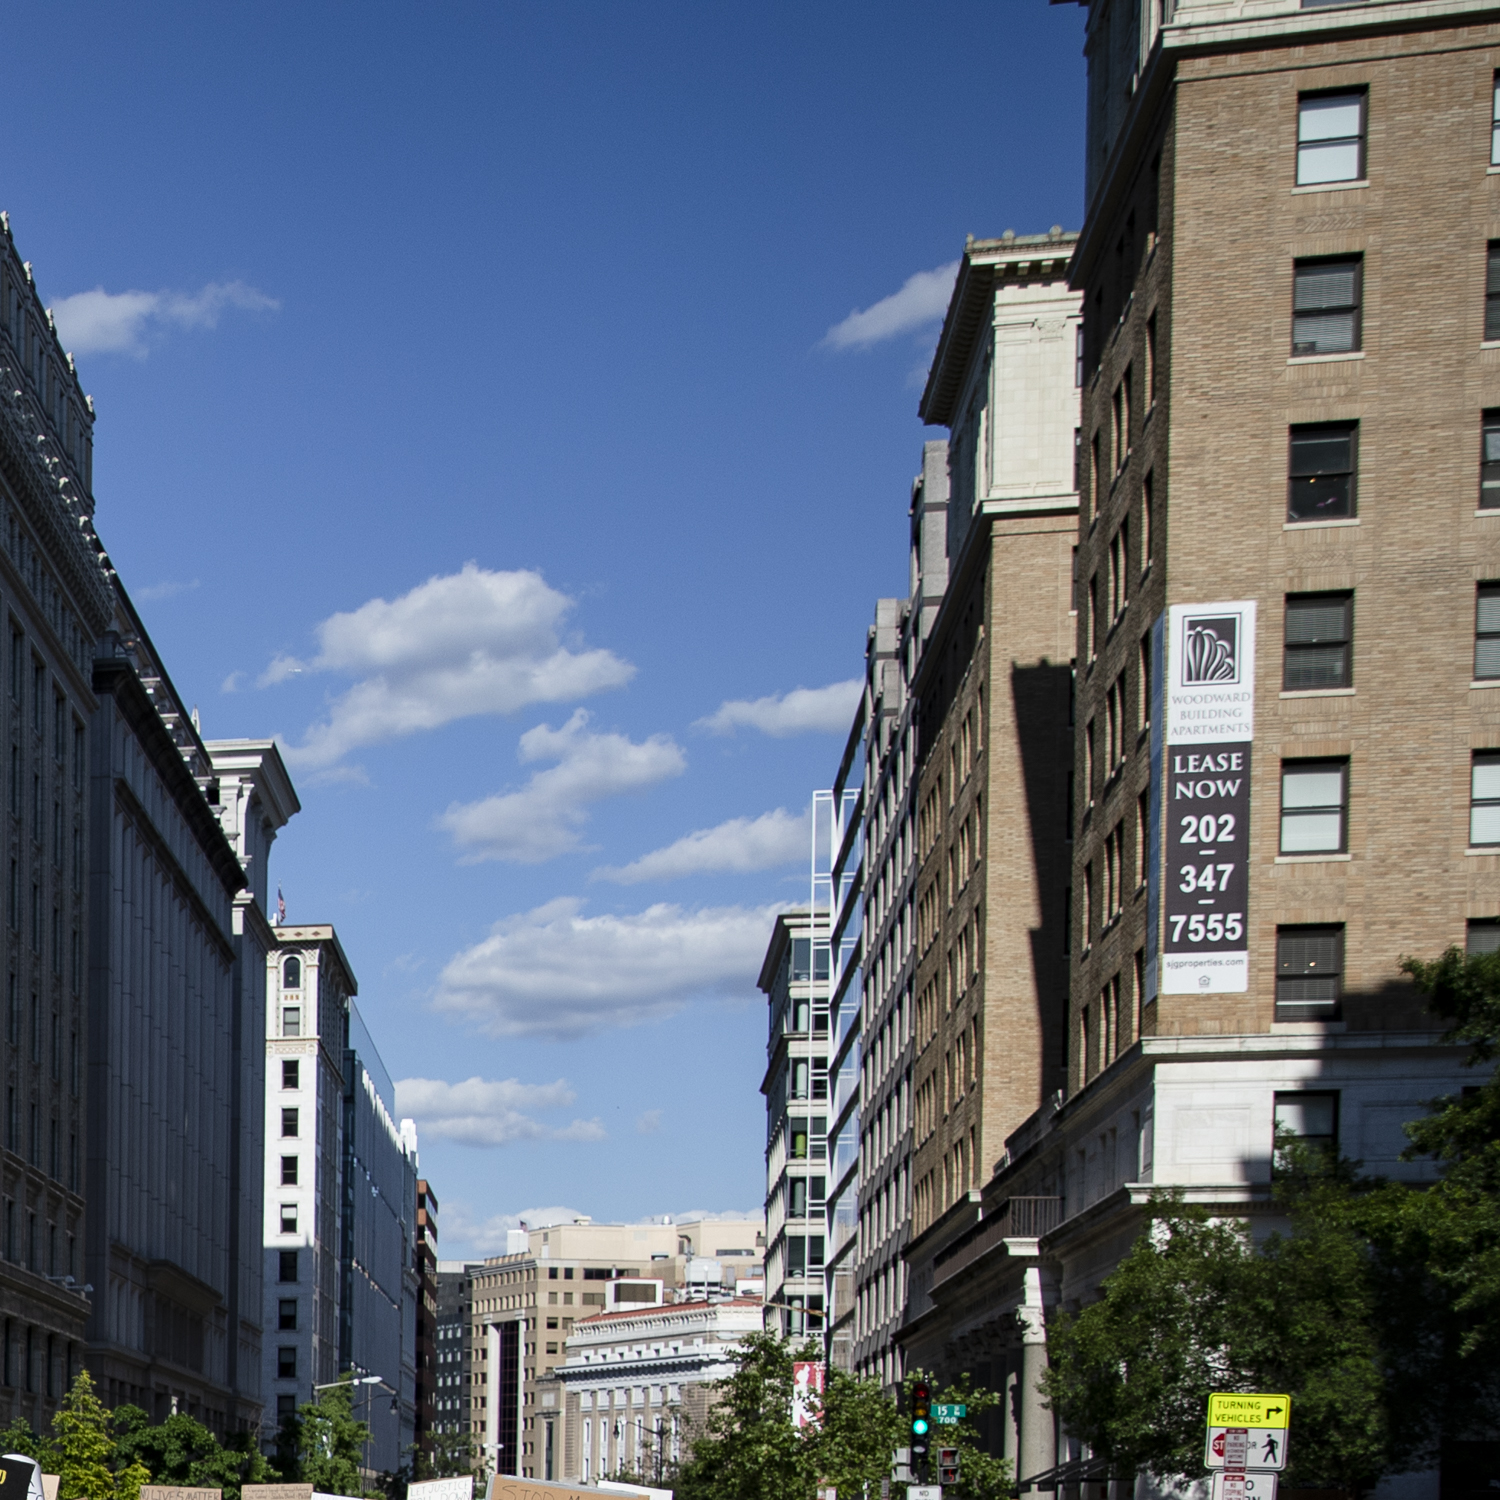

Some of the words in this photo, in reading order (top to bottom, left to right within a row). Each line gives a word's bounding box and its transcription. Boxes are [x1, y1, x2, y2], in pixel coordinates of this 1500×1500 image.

[1172, 692, 1251, 705] WOODWARD
[1180, 708, 1242, 720] BUILDING
[1171, 722, 1250, 736] APARTMENTS
[1173, 753, 1243, 774] LEASE
[1175, 779, 1241, 800] NOW
[1180, 814, 1235, 844] 202
[1179, 864, 1234, 893] 347
[1169, 912, 1243, 942] 7555
[1166, 957, 1244, 969] sjgproperties.com
[938, 1406, 948, 1416] 15
[1218, 1400, 1261, 1410] TURNING
[1215, 1413, 1262, 1423] VEHICLES
[410, 1486, 425, 1497] LET
[428, 1482, 469, 1493] JUSTICE
